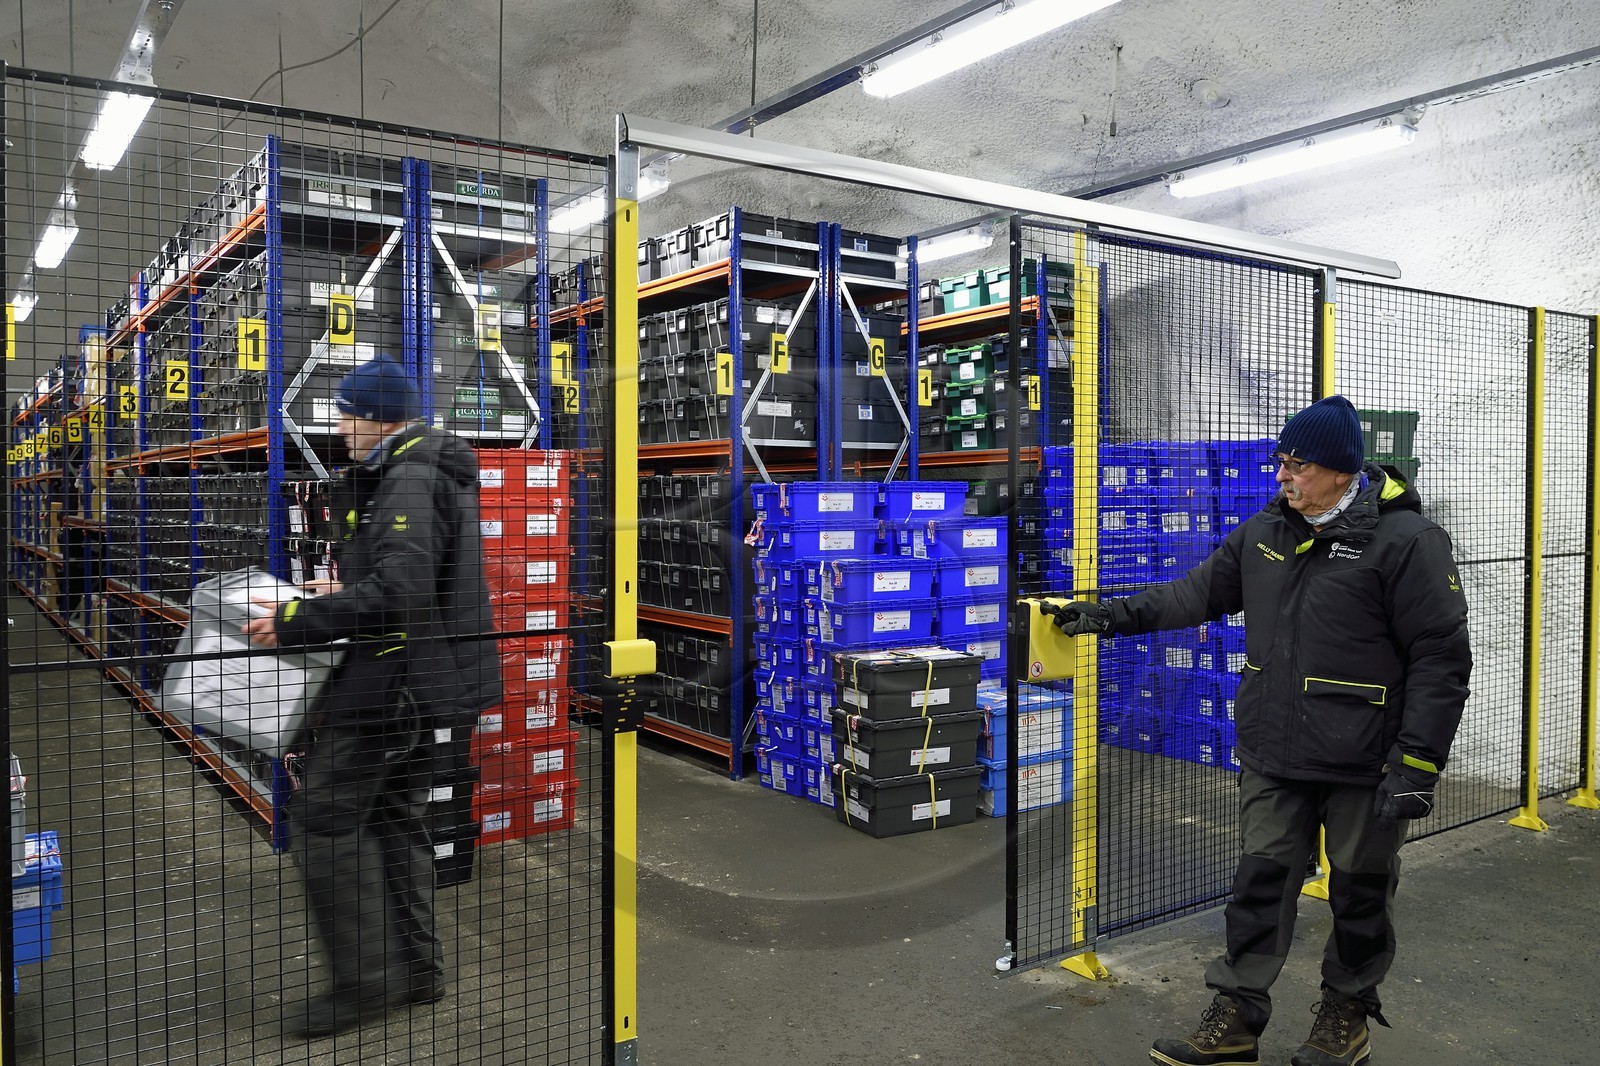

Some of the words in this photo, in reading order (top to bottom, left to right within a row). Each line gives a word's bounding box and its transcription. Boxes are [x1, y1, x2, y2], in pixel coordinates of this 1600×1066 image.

[332, 302, 353, 336] D
[482, 312, 498, 342] E
[244, 328, 262, 362] 1
[773, 340, 786, 367] F
[556, 350, 568, 380] 1
[872, 344, 884, 370] G
[168, 368, 186, 394] 2
[720, 361, 730, 388] 1
[566, 386, 578, 408] 2
[920, 376, 929, 400] 1
[1031, 382, 1038, 404] 1
[123, 391, 136, 412] 3
[70, 421, 81, 437] 5
[91, 411, 103, 427] 4
[38, 437, 46, 449] 7
[51, 430, 61, 444] 6
[17, 448, 23, 458] 9
[26, 443, 33, 454] 8
[1022, 715, 1037, 726] IITA
[1022, 769, 1037, 780] IITA
